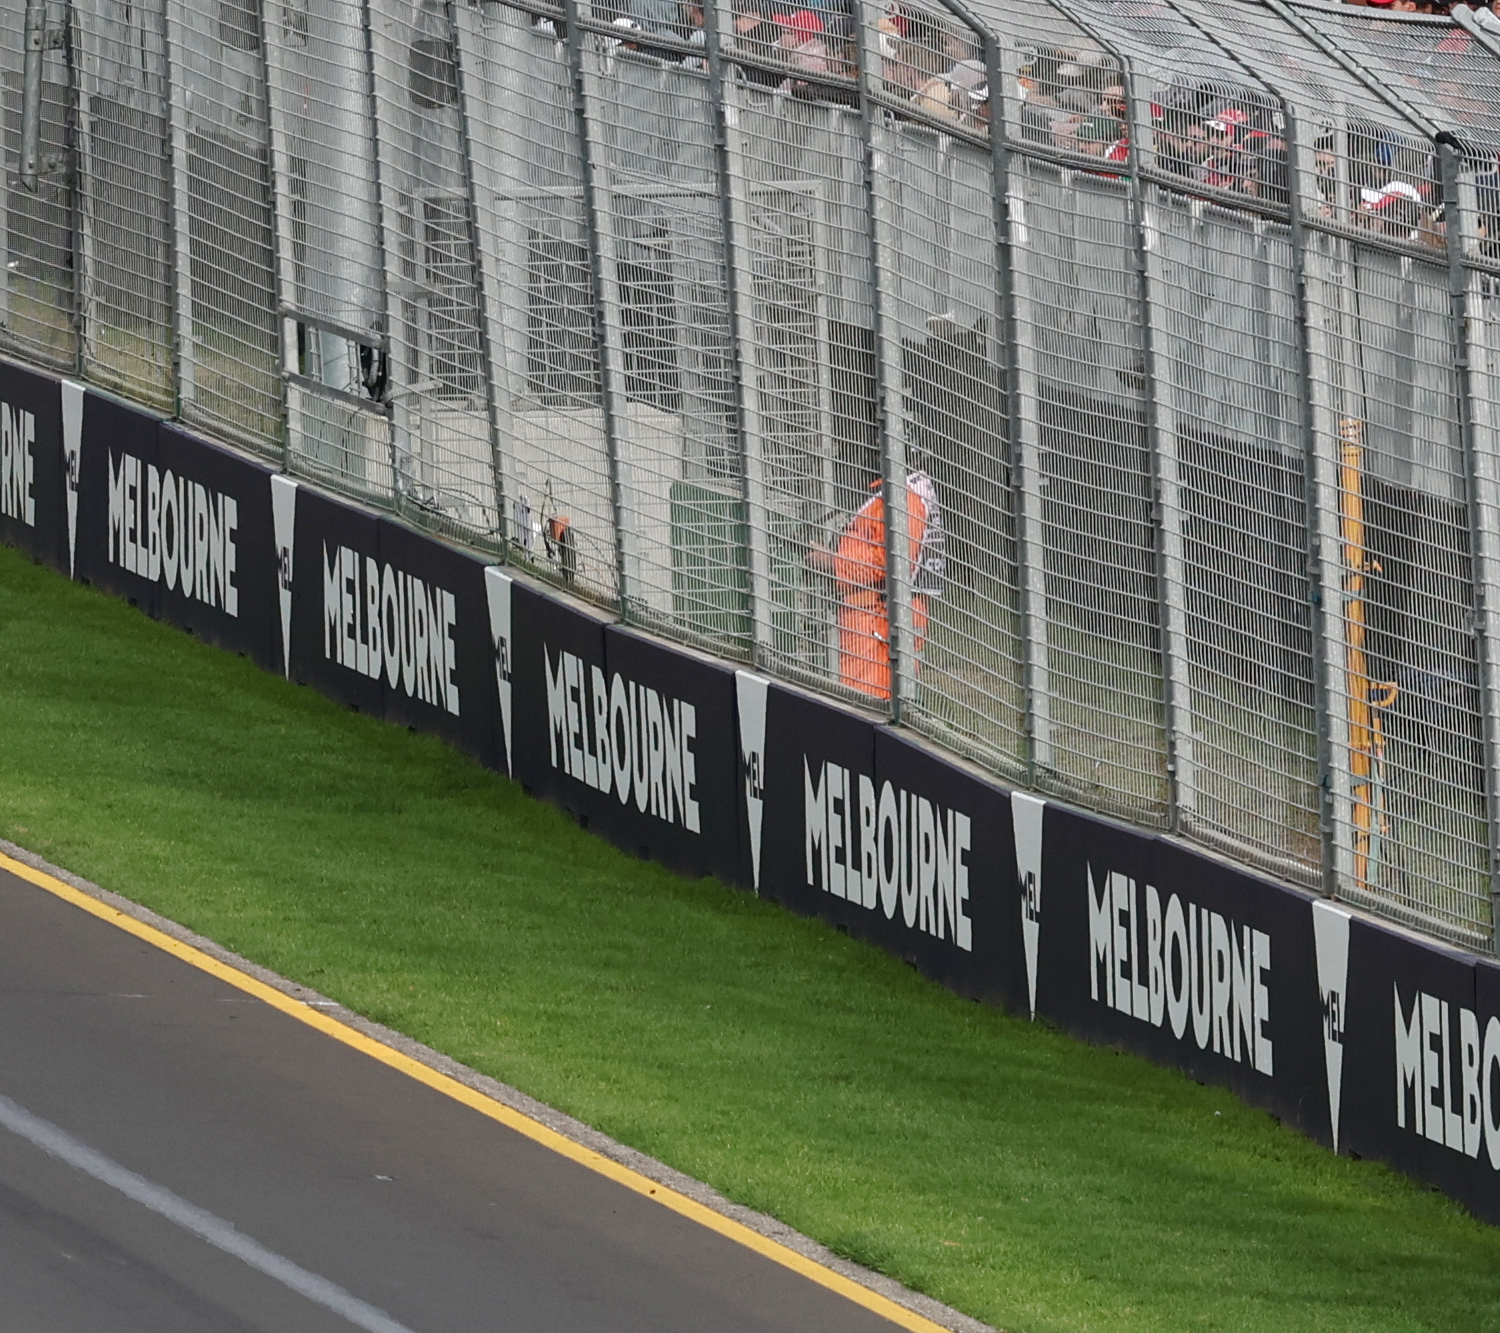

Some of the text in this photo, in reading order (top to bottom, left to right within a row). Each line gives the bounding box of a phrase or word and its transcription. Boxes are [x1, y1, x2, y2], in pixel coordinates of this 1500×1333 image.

[108, 447, 239, 618] MELBOURNE
[323, 539, 460, 716] MELBOURNE
[544, 642, 701, 834] MELBOURNE
[803, 753, 973, 952] MELBOURNE
[1087, 861, 1273, 1077] MELBOURNE
[1320, 986, 1345, 1045] MEL
